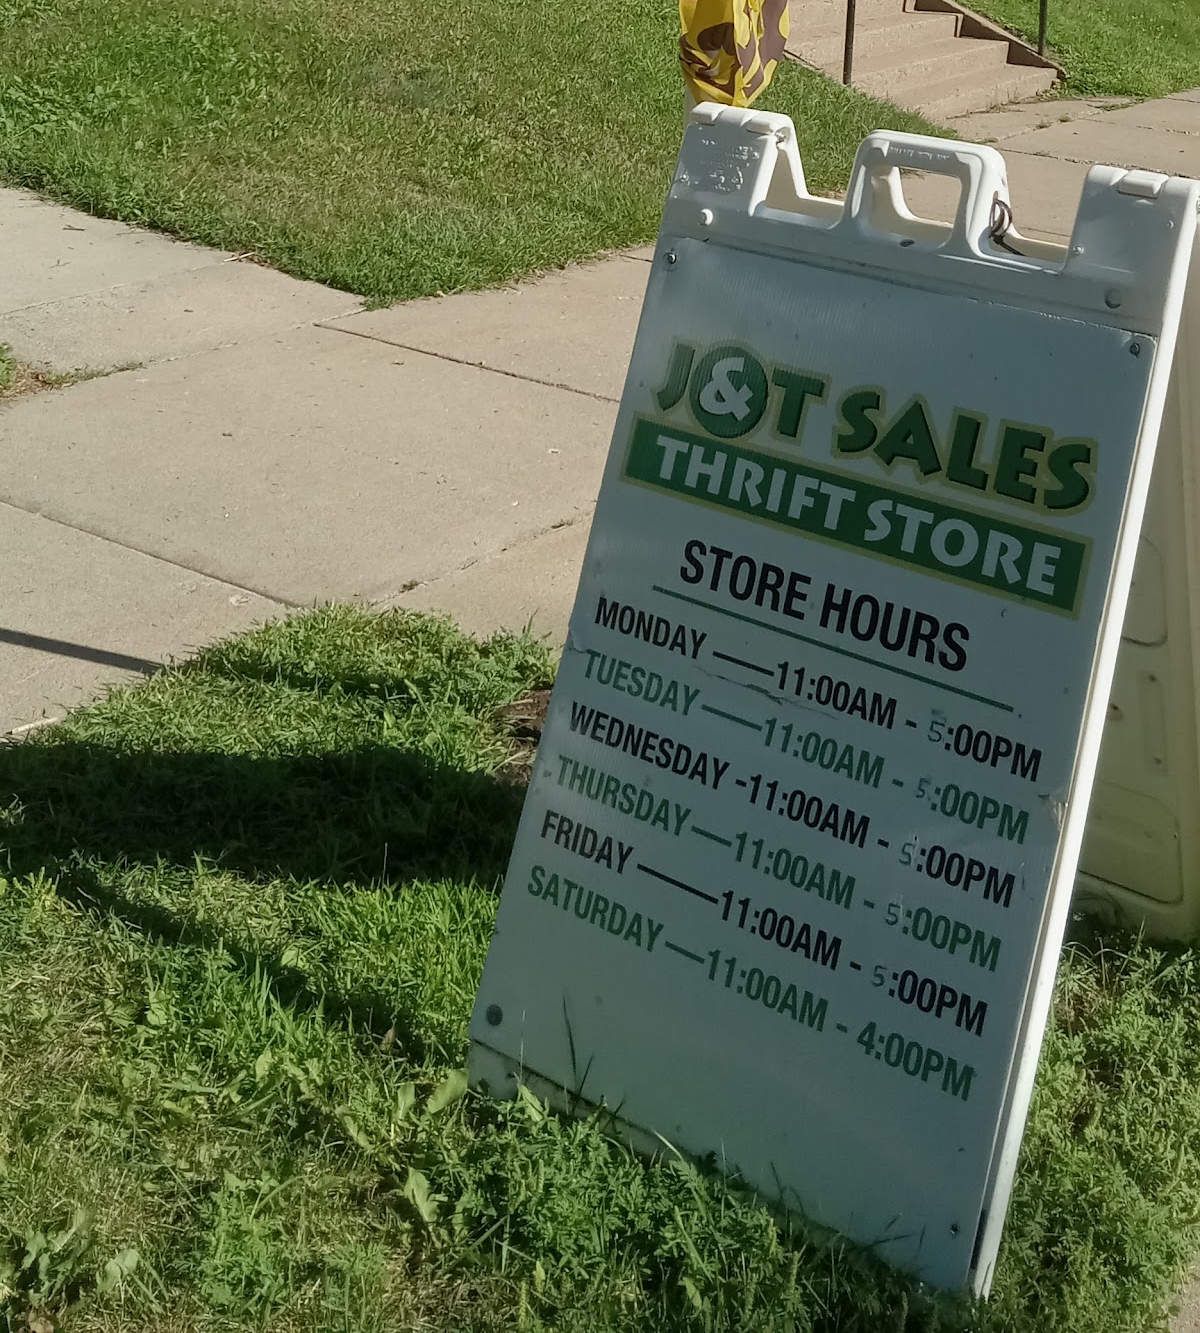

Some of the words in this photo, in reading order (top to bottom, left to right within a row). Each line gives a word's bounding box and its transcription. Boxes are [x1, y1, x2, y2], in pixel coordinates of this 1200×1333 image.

[655, 434, 856, 531] THRIFT
[864, 499, 1062, 596] STORE
[656, 342, 826, 439] J&T
[837, 390, 1092, 510] SALES
[594, 596, 707, 660] MONDAY
[928, 720, 1042, 792] 5:00PM
[679, 539, 812, 620] STORE
[819, 582, 971, 672] HOURS
[568, 701, 730, 790] WEDNESDAY
[899, 842, 1016, 909] 5:00PM
[584, 648, 700, 716] TUESDAY
[915, 777, 1030, 845] 5:00PM
[540, 809, 634, 875] FRIDAY
[871, 965, 988, 1037] 5:00PM
[557, 755, 692, 838] THURSDAY
[884, 902, 1002, 973] 5:00PM
[527, 865, 664, 953] SATURDAY
[857, 1021, 976, 1102] 4:00PM
